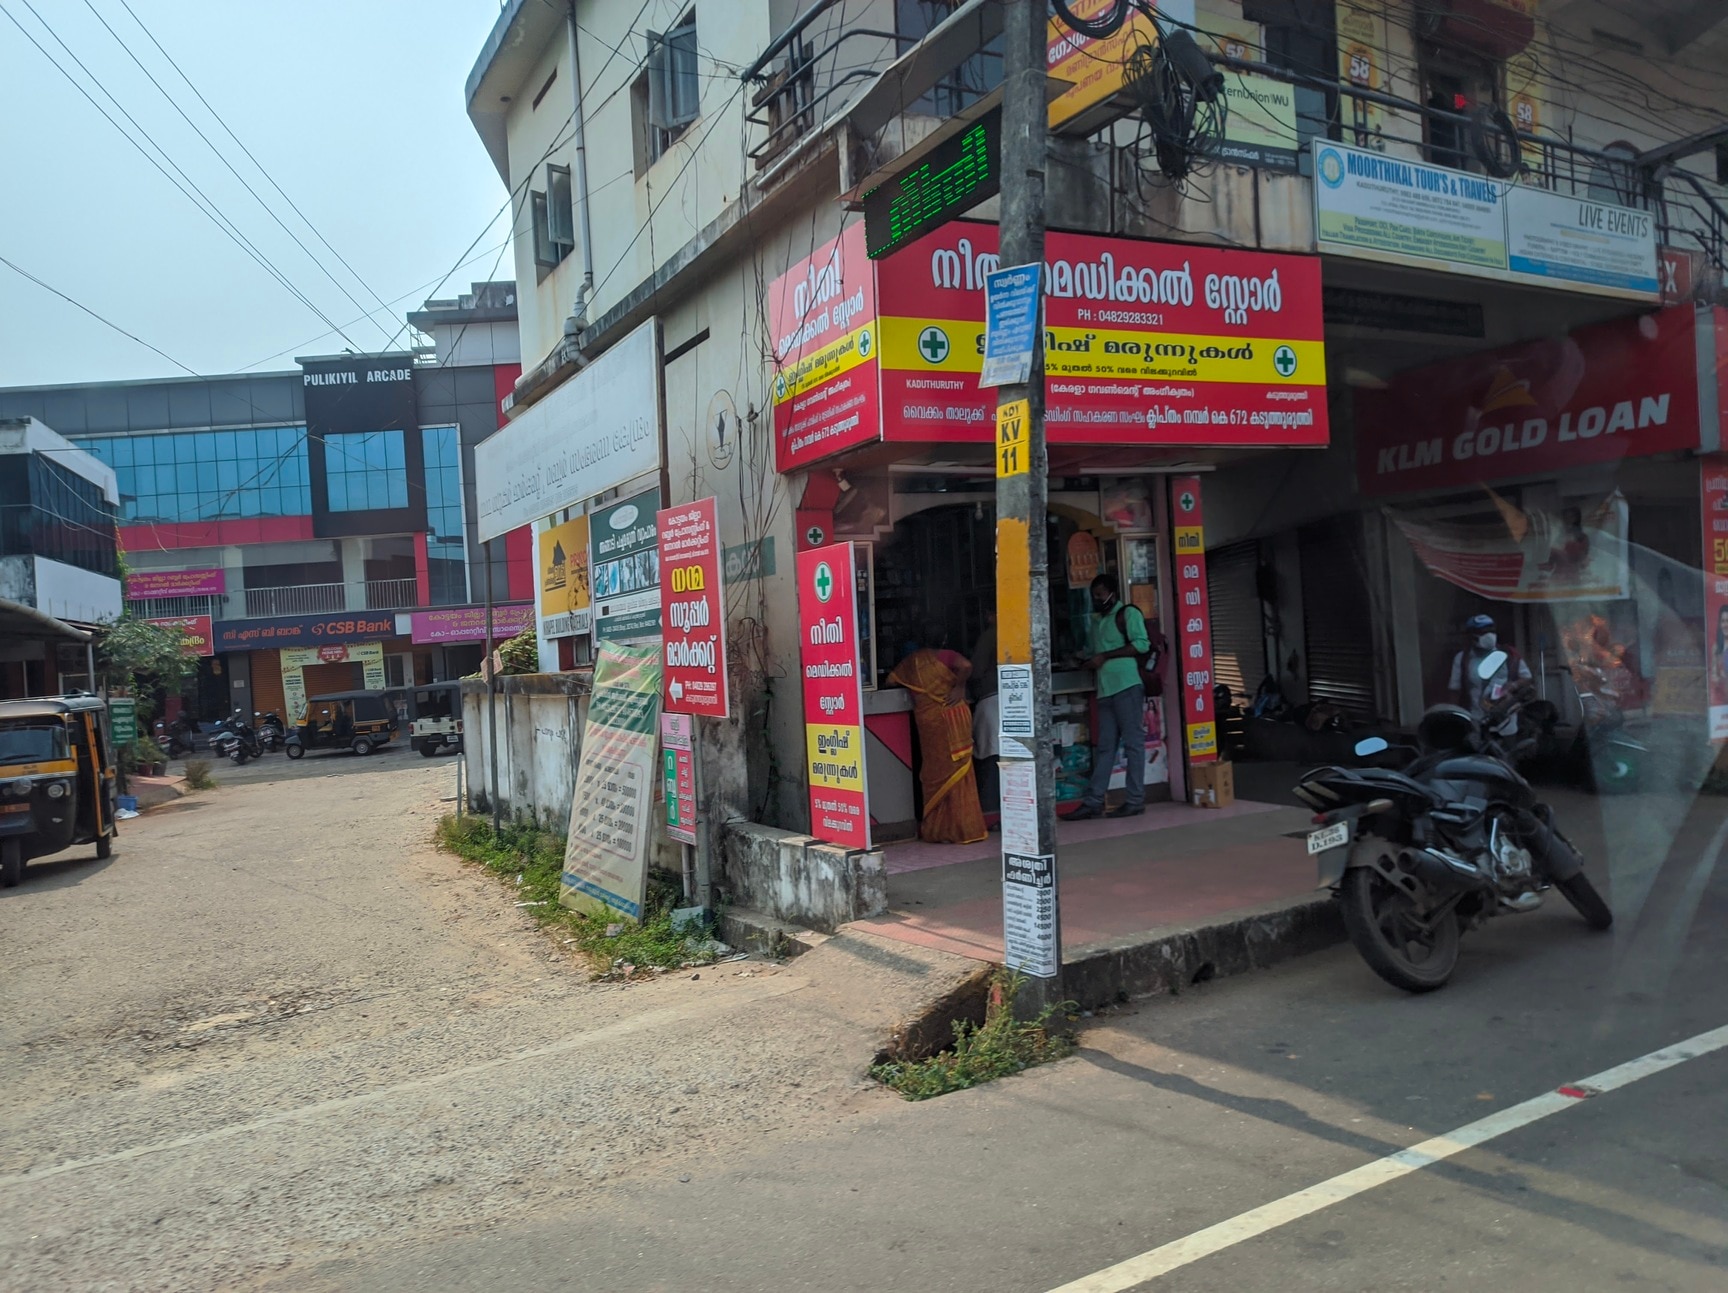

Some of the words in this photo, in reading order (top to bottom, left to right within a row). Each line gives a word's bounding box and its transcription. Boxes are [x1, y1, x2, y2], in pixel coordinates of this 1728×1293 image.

[1350, 55, 1369, 79] 58
[1517, 102, 1533, 122] 58
[1347, 152, 1413, 188] MOORTHIKAL
[1414, 167, 1449, 194] TOUR'S
[1450, 183, 1457, 196] &
[1458, 177, 1497, 205] TRAVELS
[1579, 203, 1604, 230] LIVE
[1607, 210, 1648, 238] EVENTS
[794, 247, 842, 321] നീതി
[1204, 266, 1283, 326] സ്റ്റോർ
[1077, 308, 1091, 321] PH
[1104, 341, 1253, 365] മരുന്നുകൾ
[304, 372, 358, 386] PULIKIYIL
[367, 369, 411, 382] ARCADE
[906, 379, 964, 390] KADUTHURUTHY
[1229, 408, 1247, 425] 672
[1001, 418, 1021, 444] KV
[1376, 438, 1442, 475] KLM
[1452, 418, 1549, 461] GOLD
[1557, 393, 1671, 443] LOAN
[1002, 446, 1018, 474] 11
[671, 564, 705, 593] നന്മ
[326, 621, 355, 635] CSB
[356, 619, 392, 633] Bank
[670, 595, 710, 634] സൂപ്പർ
[810, 615, 844, 646] നീതി
[666, 634, 717, 675] മാർക്കറ്റ്
[805, 659, 853, 680] മെഡിക്കൽ
[819, 692, 845, 717] സ്റ്റോർ
[812, 760, 857, 784] മരുന്നുകൾ
